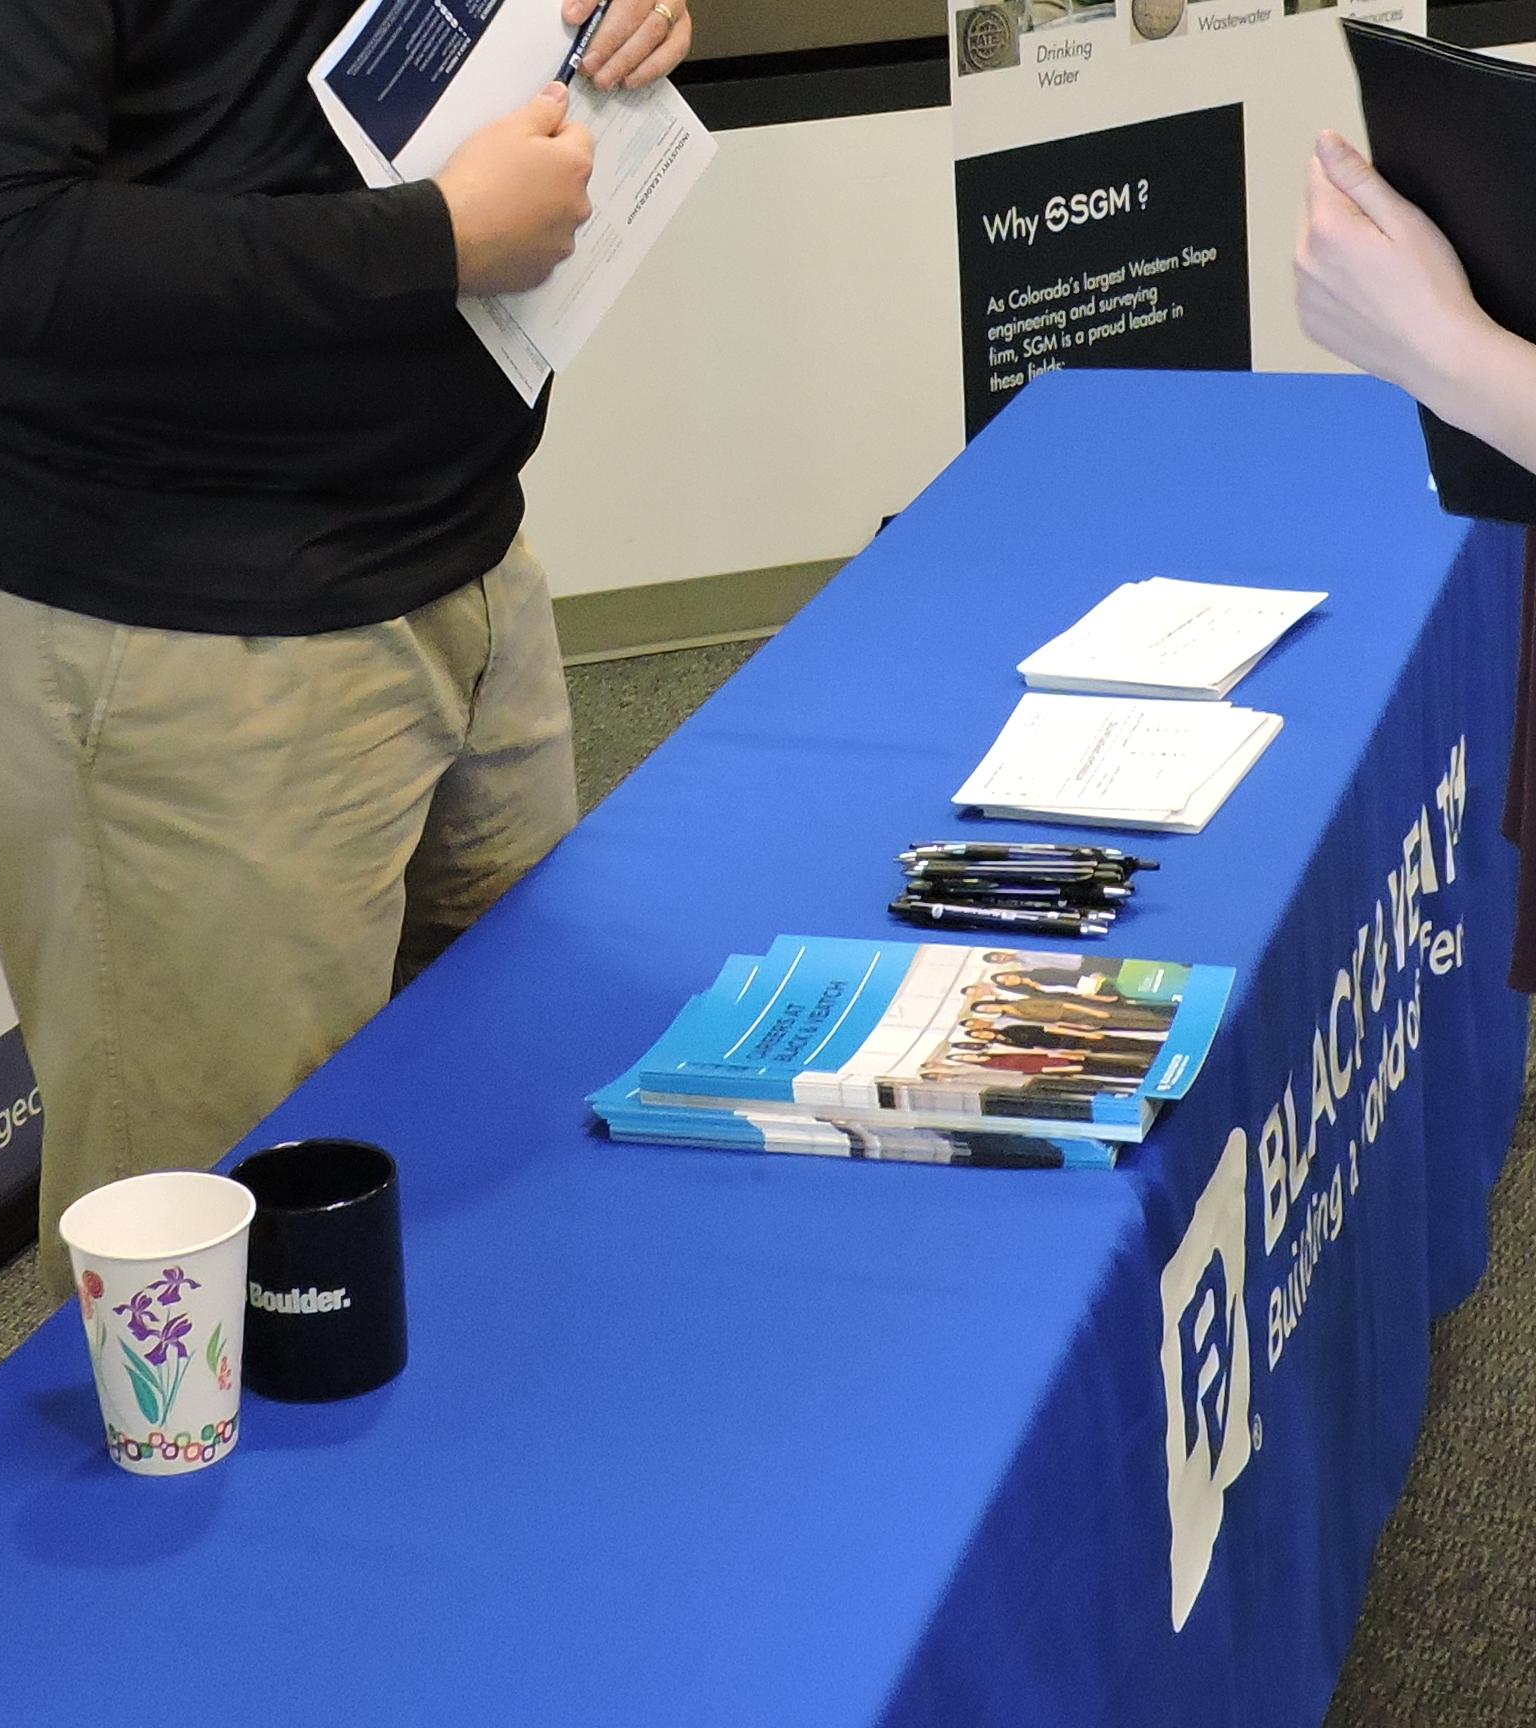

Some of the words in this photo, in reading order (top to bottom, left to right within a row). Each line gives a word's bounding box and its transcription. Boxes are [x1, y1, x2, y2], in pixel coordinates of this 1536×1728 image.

[1199, 8, 1272, 32] Wastewater
[1037, 40, 1093, 64] Drinking
[1038, 70, 1080, 89] Water
[983, 206, 1039, 246] Why
[1070, 183, 1131, 224] SGM
[1138, 179, 1149, 210] ?
[987, 296, 1005, 315] As
[1008, 277, 1080, 309] Colorado's
[1084, 266, 1126, 292] largest
[1128, 255, 1180, 279] Western
[1182, 246, 1217, 268] Slope
[988, 306, 1066, 342] engineering
[1070, 295, 1095, 320] and
[1099, 286, 1158, 314] surveying
[1023, 334, 1058, 358] SGM
[1062, 331, 1072, 348] is
[1075, 329, 1084, 345] a
[1088, 319, 1126, 348] proud
[1129, 307, 1168, 330] leader
[1171, 302, 1183, 319] in
[990, 372, 1024, 393] these
[1268, 1162, 1343, 1373] Building
[1349, 1139, 1359, 1197] a
[1360, 998, 1406, 1144] orld
